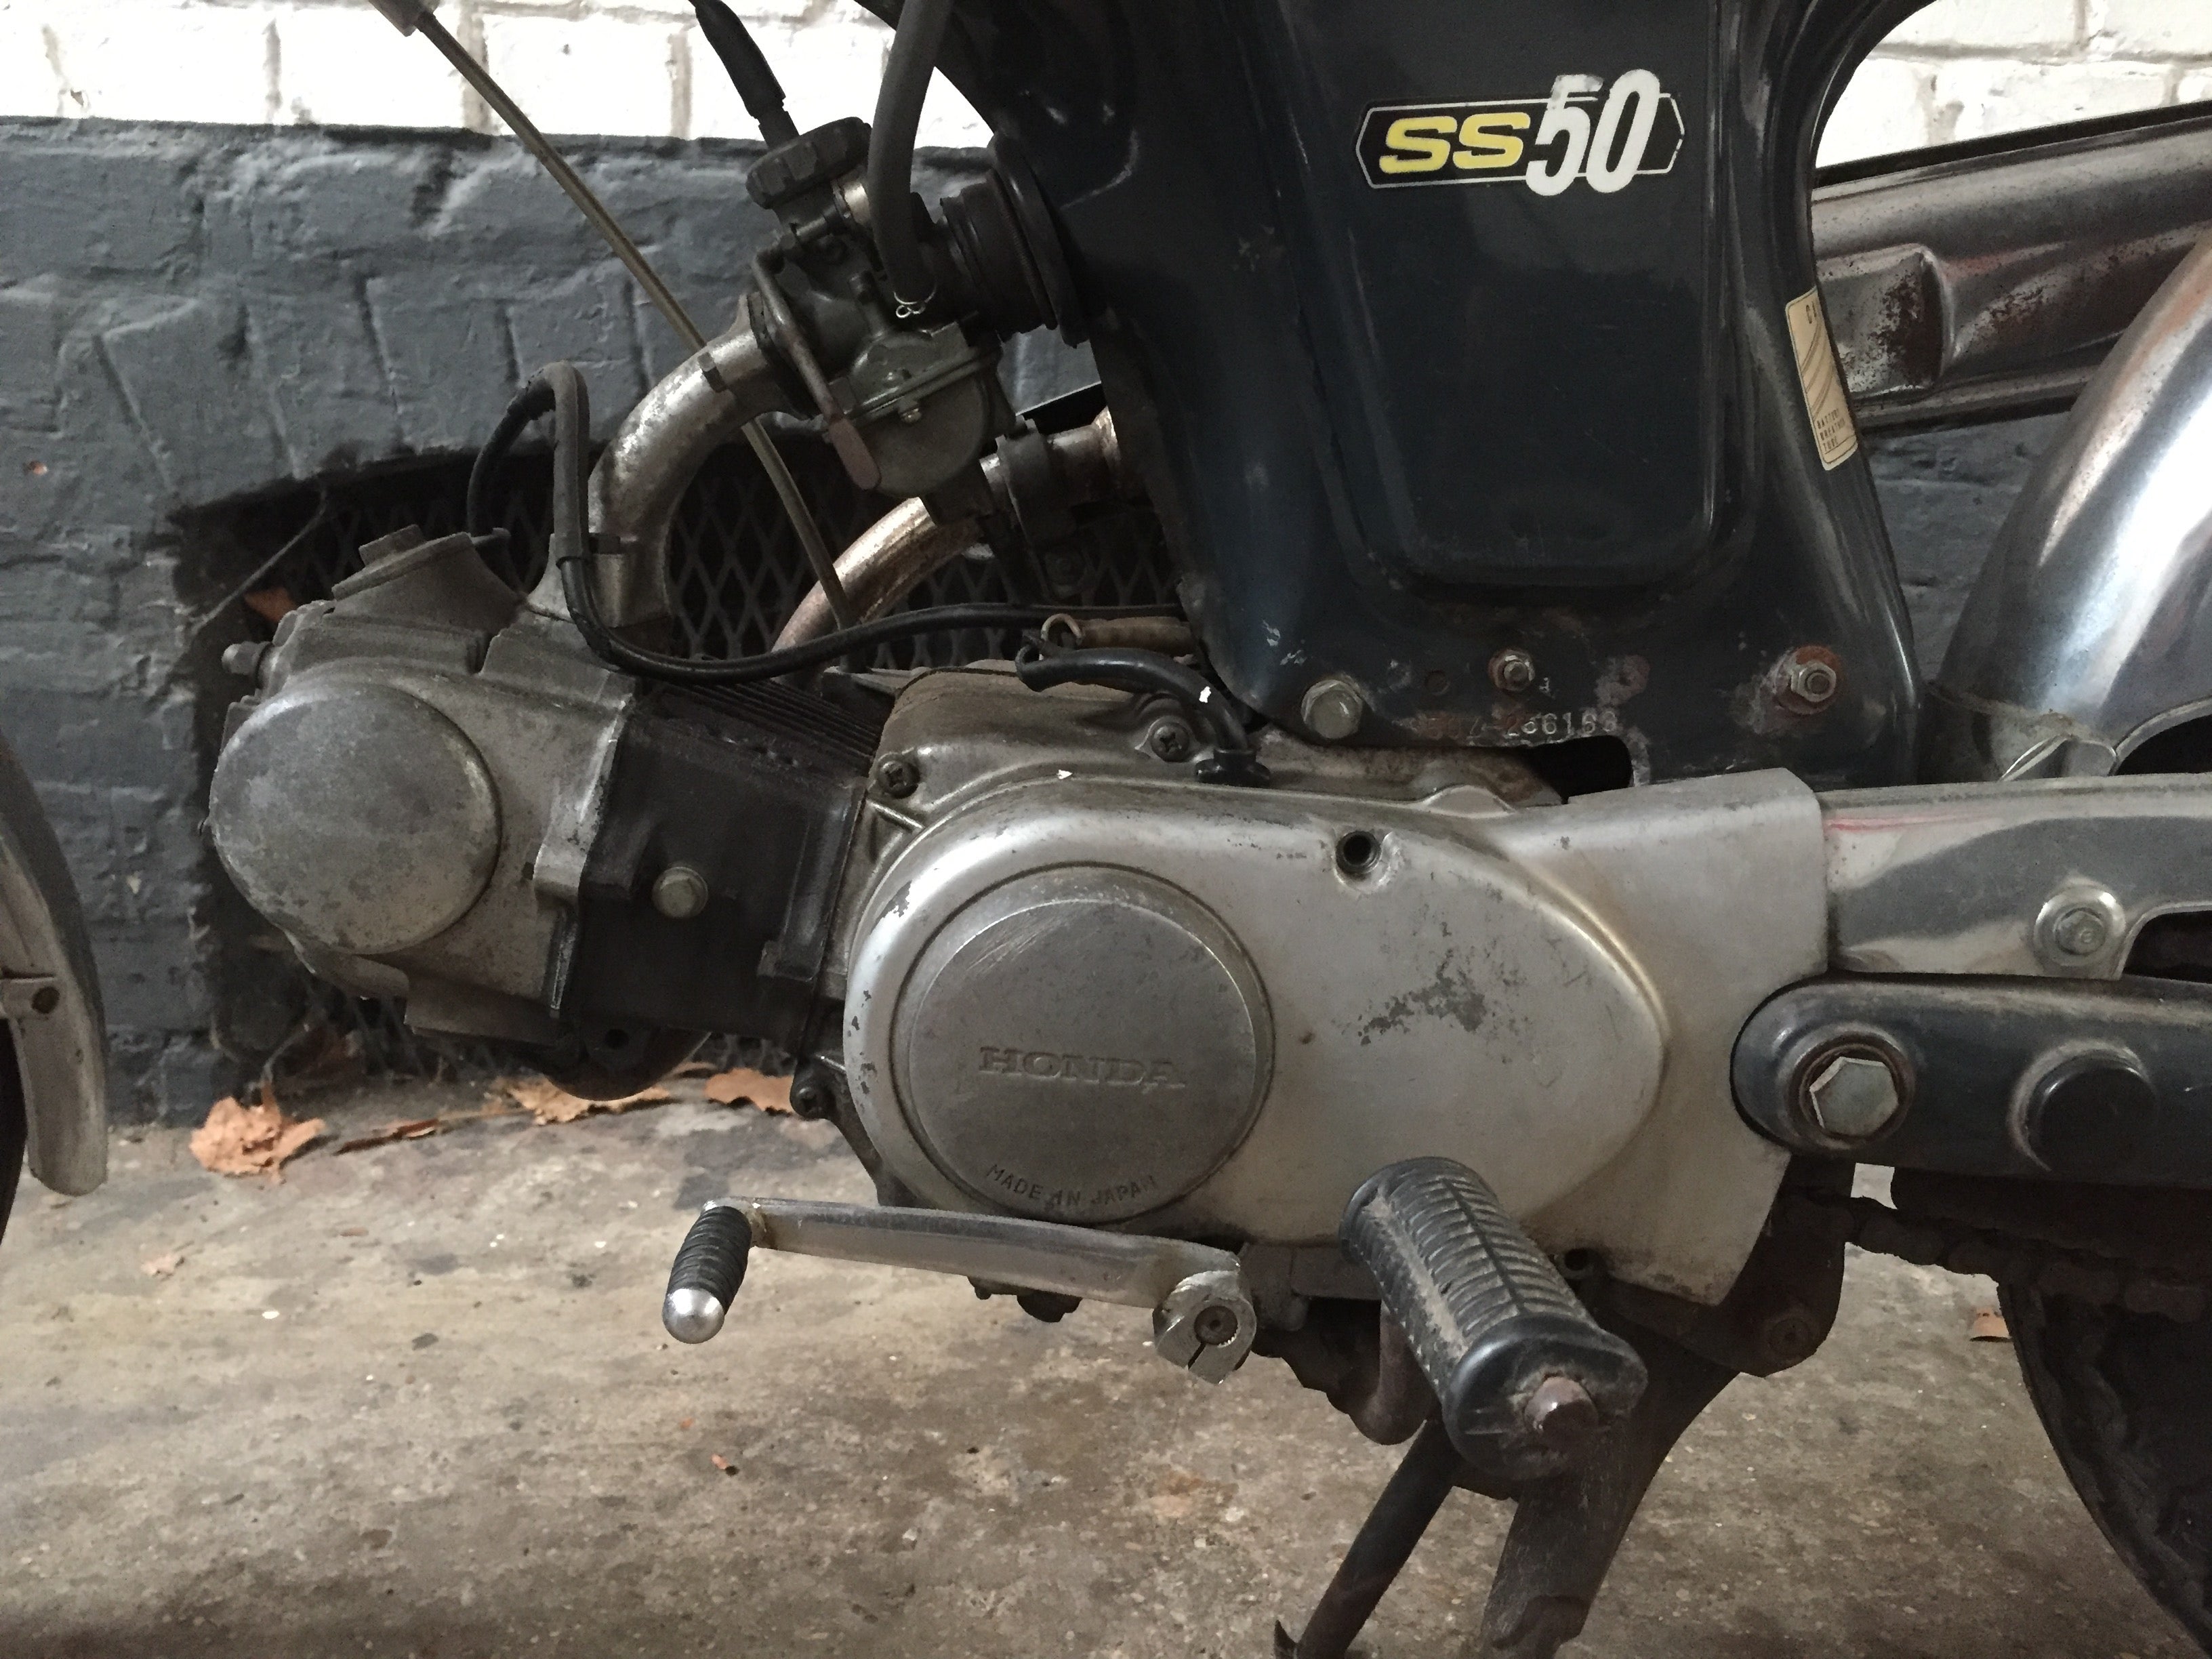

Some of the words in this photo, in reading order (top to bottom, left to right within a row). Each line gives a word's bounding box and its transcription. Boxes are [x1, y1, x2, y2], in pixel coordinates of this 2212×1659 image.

[979, 1046, 1185, 1088] HONDA
[987, 1164, 1042, 1200] MADE
[1091, 1174, 1156, 1206] JAPAN
